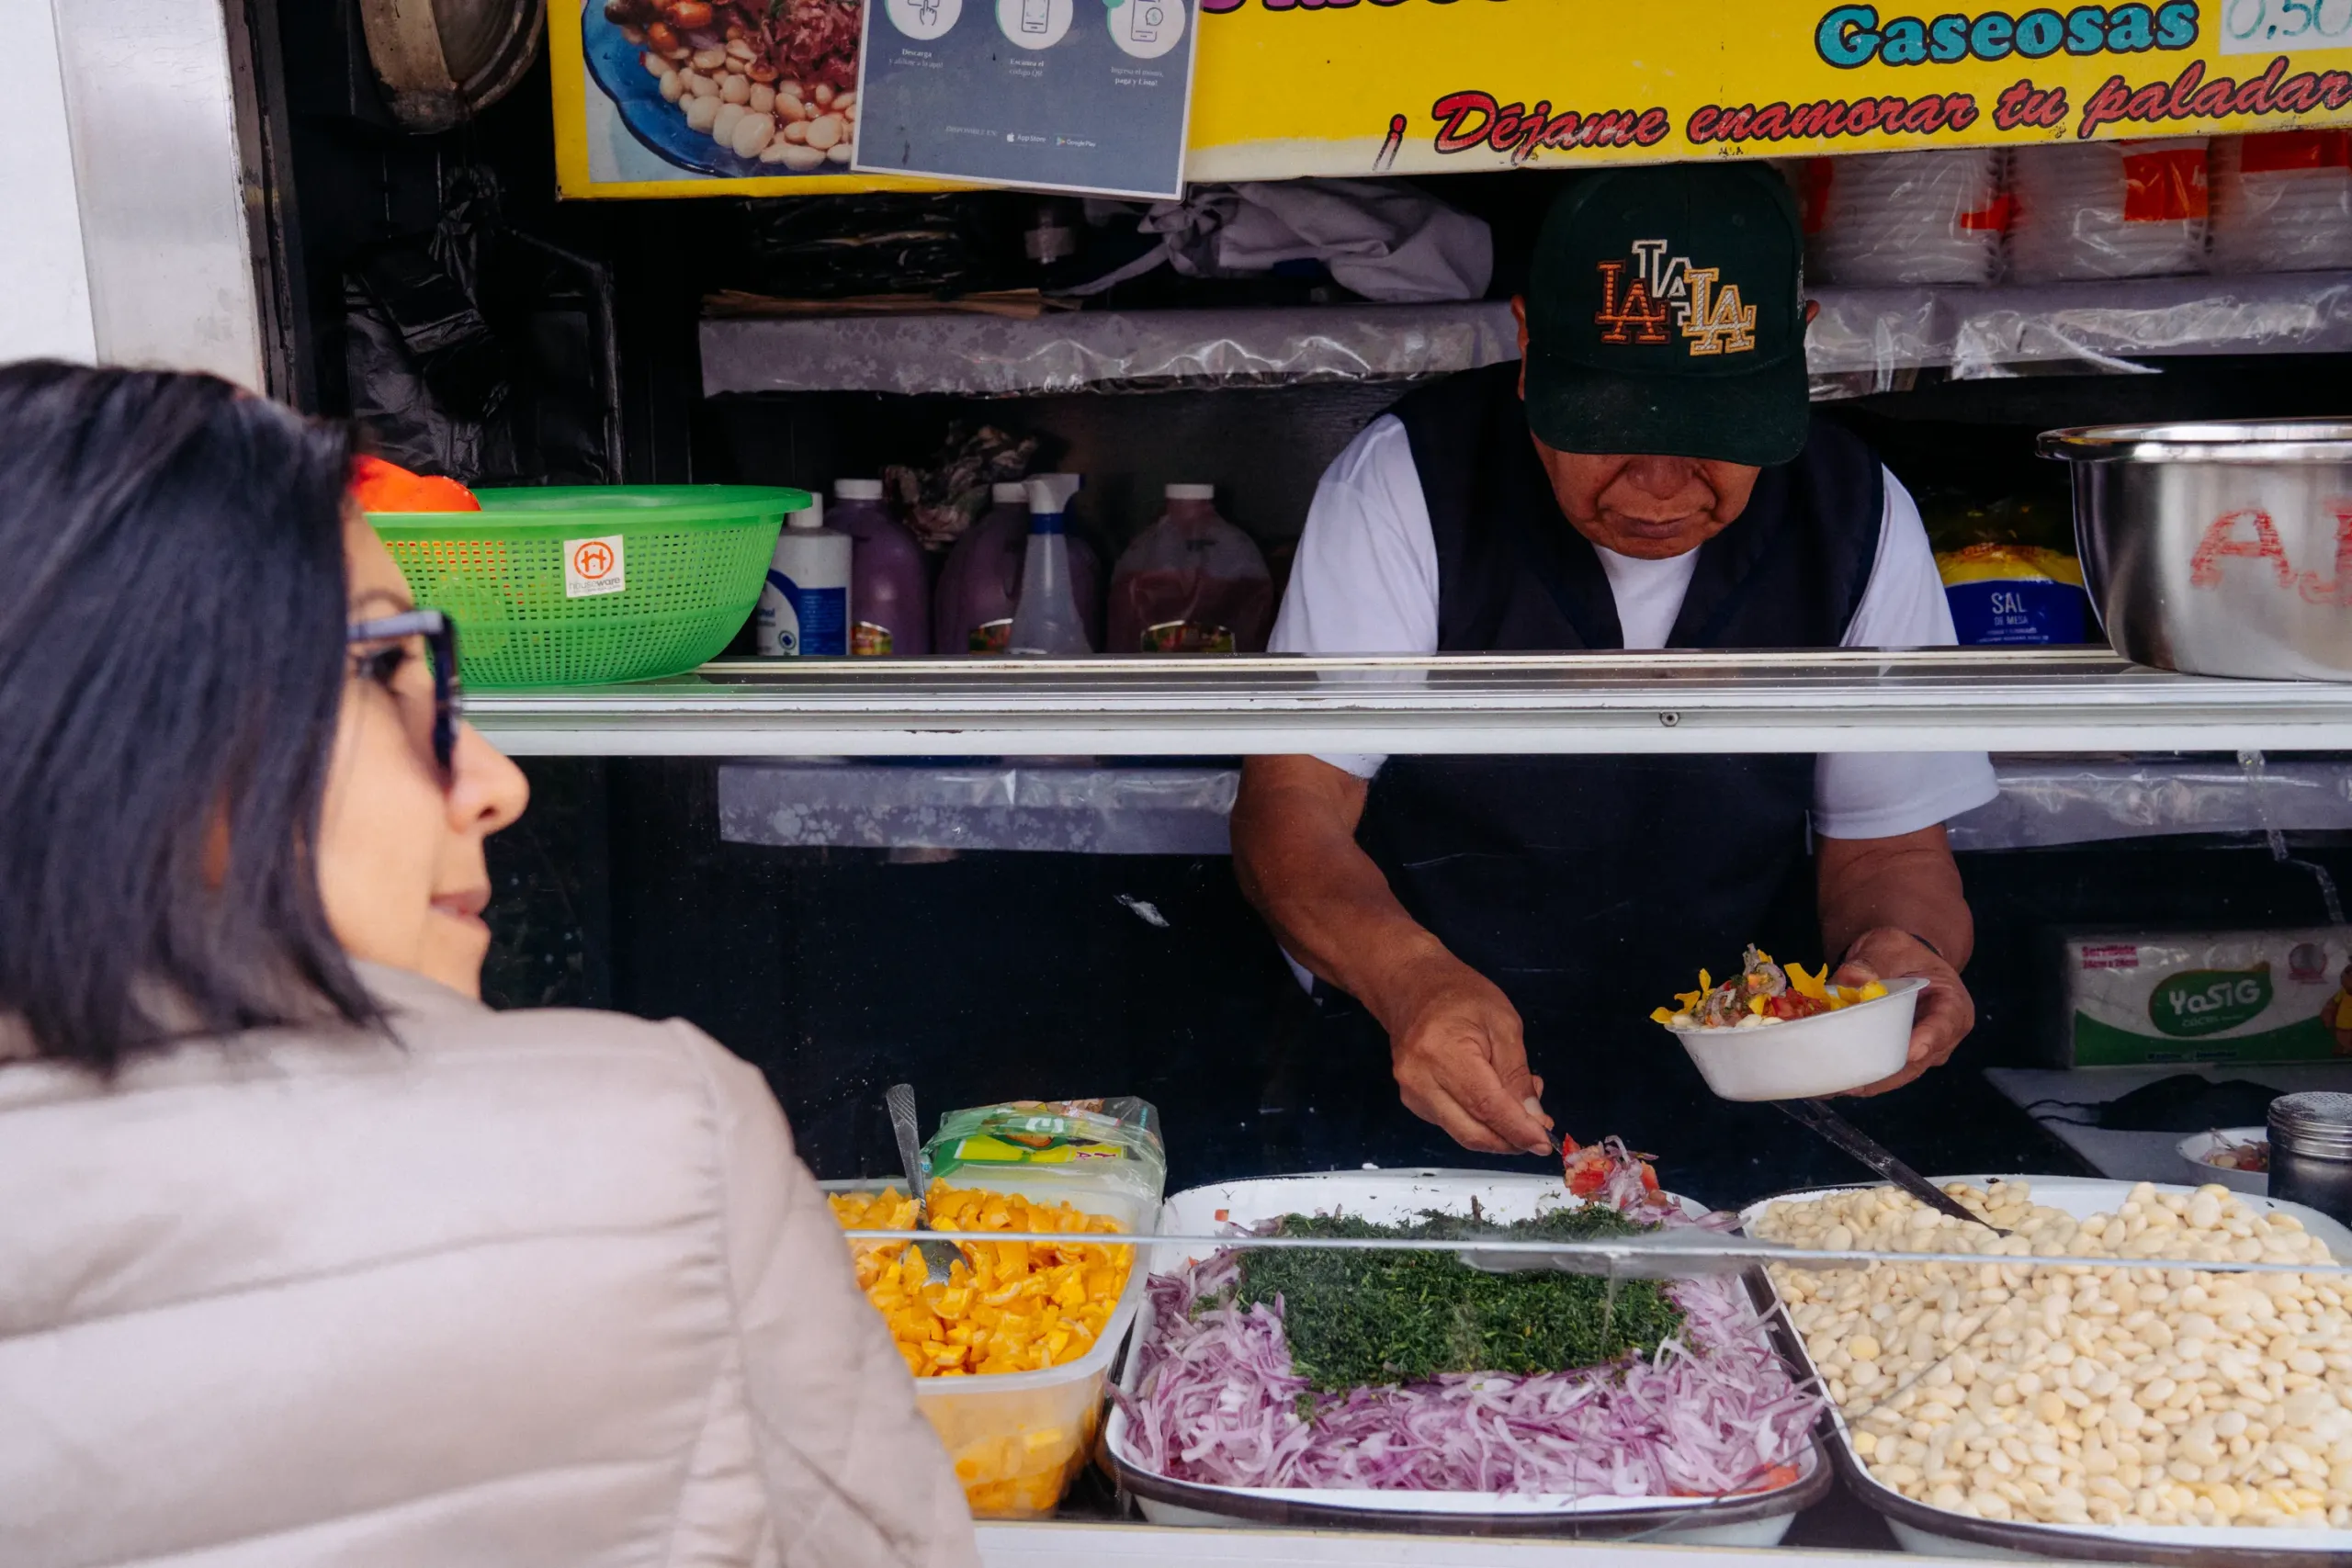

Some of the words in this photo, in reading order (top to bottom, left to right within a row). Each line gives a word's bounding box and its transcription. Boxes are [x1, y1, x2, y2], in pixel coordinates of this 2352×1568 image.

[1815, 0, 2199, 69] Gaseosas
[901, 49, 933, 59] Descarga
[1431, 90, 1670, 167] Déjame
[1686, 92, 1980, 145] enamorar
[1992, 79, 2069, 131] tu
[2076, 55, 2352, 140] paladar
[1017, 134, 1029, 142] App
[1030, 135, 1046, 143] Store
[1066, 139, 1085, 148] Google
[1595, 258, 1671, 345] LA
[1682, 267, 1757, 356] LA
[569, 577, 621, 591] houseware
[1991, 592, 2029, 615] SAL
[1995, 616, 2004, 626] DE
[2007, 615, 2029, 626] MESA
